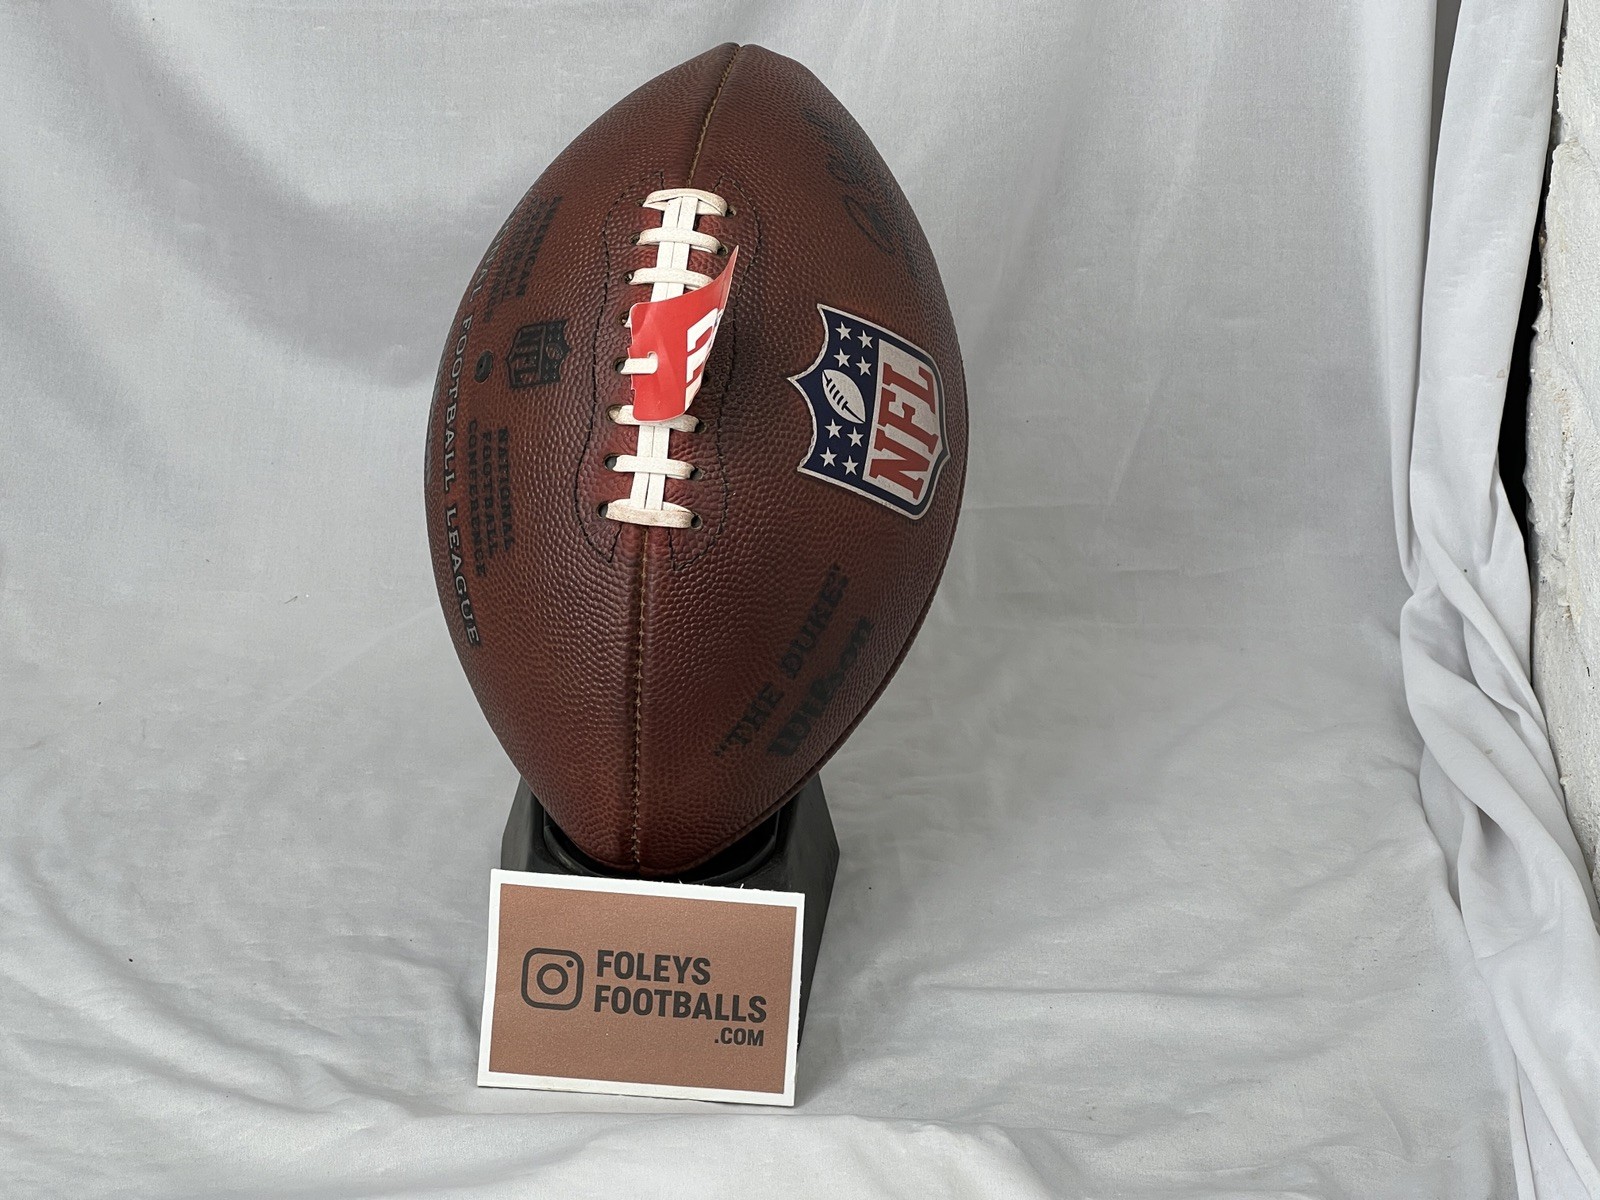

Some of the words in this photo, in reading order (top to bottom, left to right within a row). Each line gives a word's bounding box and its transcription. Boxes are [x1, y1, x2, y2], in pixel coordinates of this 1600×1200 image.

[444, 314, 473, 491] FOOTBALL
[869, 361, 939, 500] NFL
[468, 420, 487, 577] CONFERENCE
[482, 430, 498, 557] FOOTBALL
[498, 427, 515, 550] NATIONAL
[446, 506, 480, 645] LEAGUE
[593, 984, 767, 1023] FOOTBALLS
[596, 949, 711, 985] FOLEYS
[714, 1027, 765, 1047] .COM
